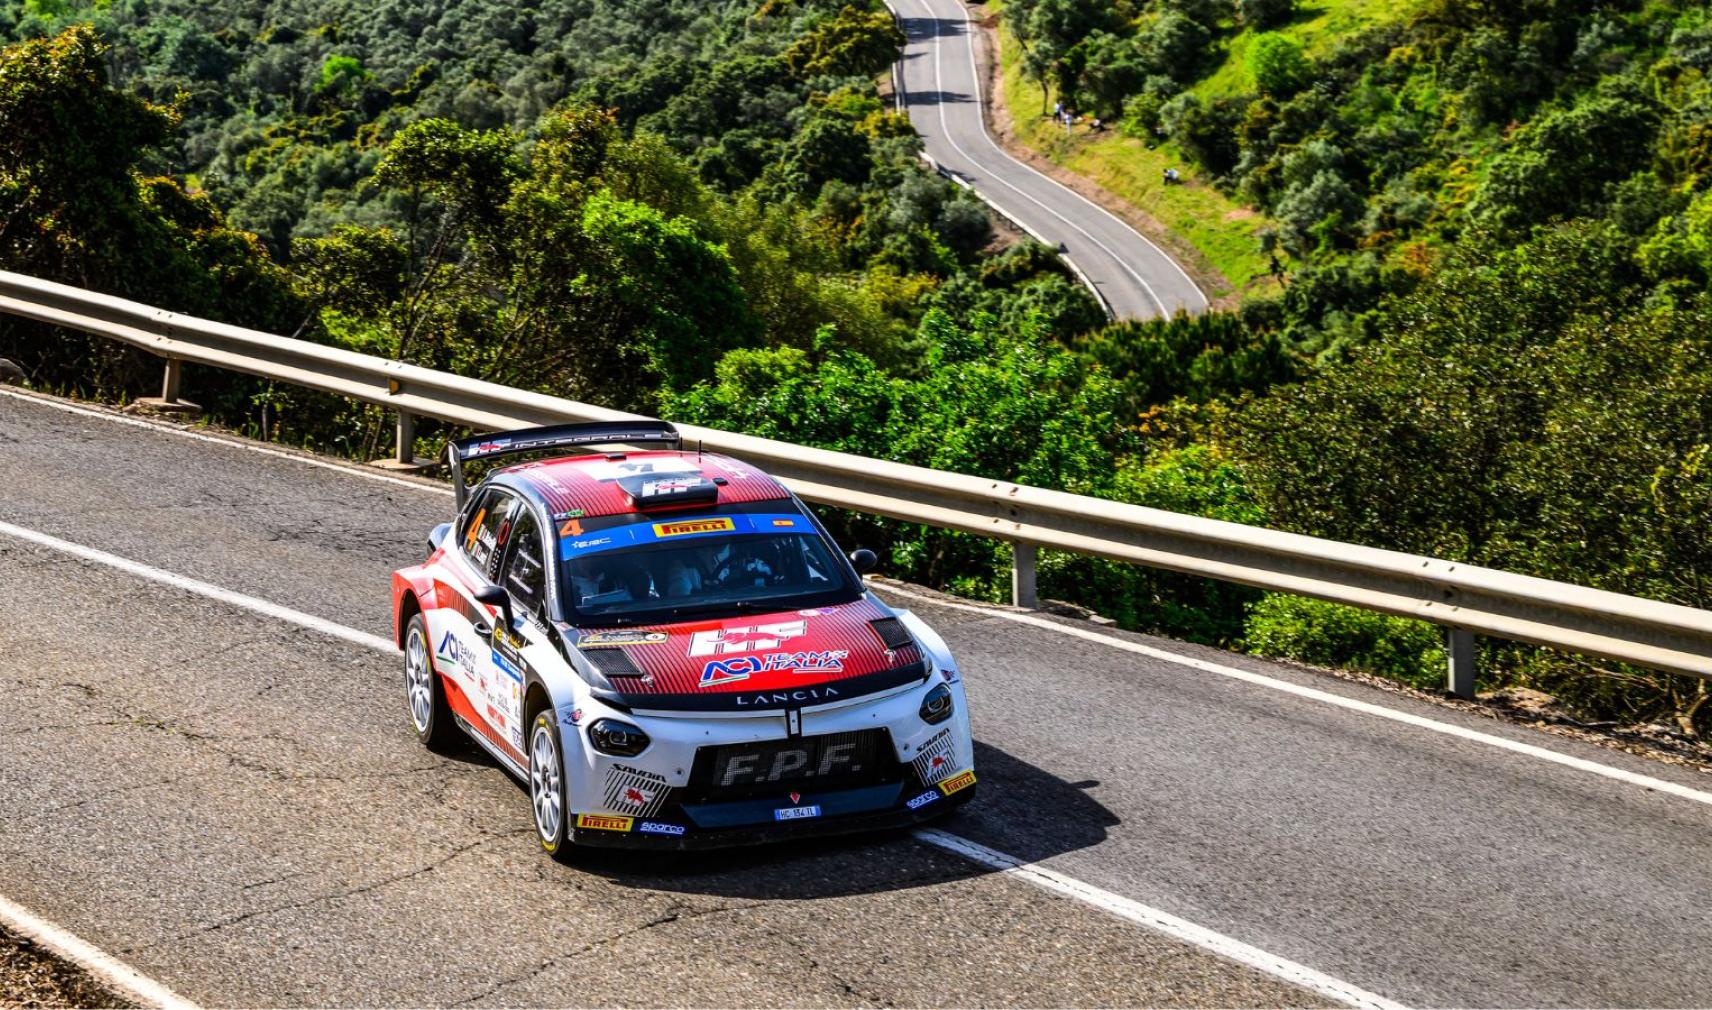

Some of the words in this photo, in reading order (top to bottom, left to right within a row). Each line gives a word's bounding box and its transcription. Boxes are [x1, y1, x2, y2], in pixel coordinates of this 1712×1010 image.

[466, 507, 486, 551] 4
[560, 519, 584, 538] 4
[661, 520, 727, 535] PIRELLI
[764, 651, 829, 662] TEAM
[764, 659, 843, 671] ITALIA
[736, 687, 839, 705] LANCIA
[721, 742, 862, 786] F.P.F.
[943, 771, 973, 793] PIRELLI
[905, 791, 940, 809] sparco
[581, 815, 629, 829] PIRELLI
[640, 821, 686, 834] sparco
